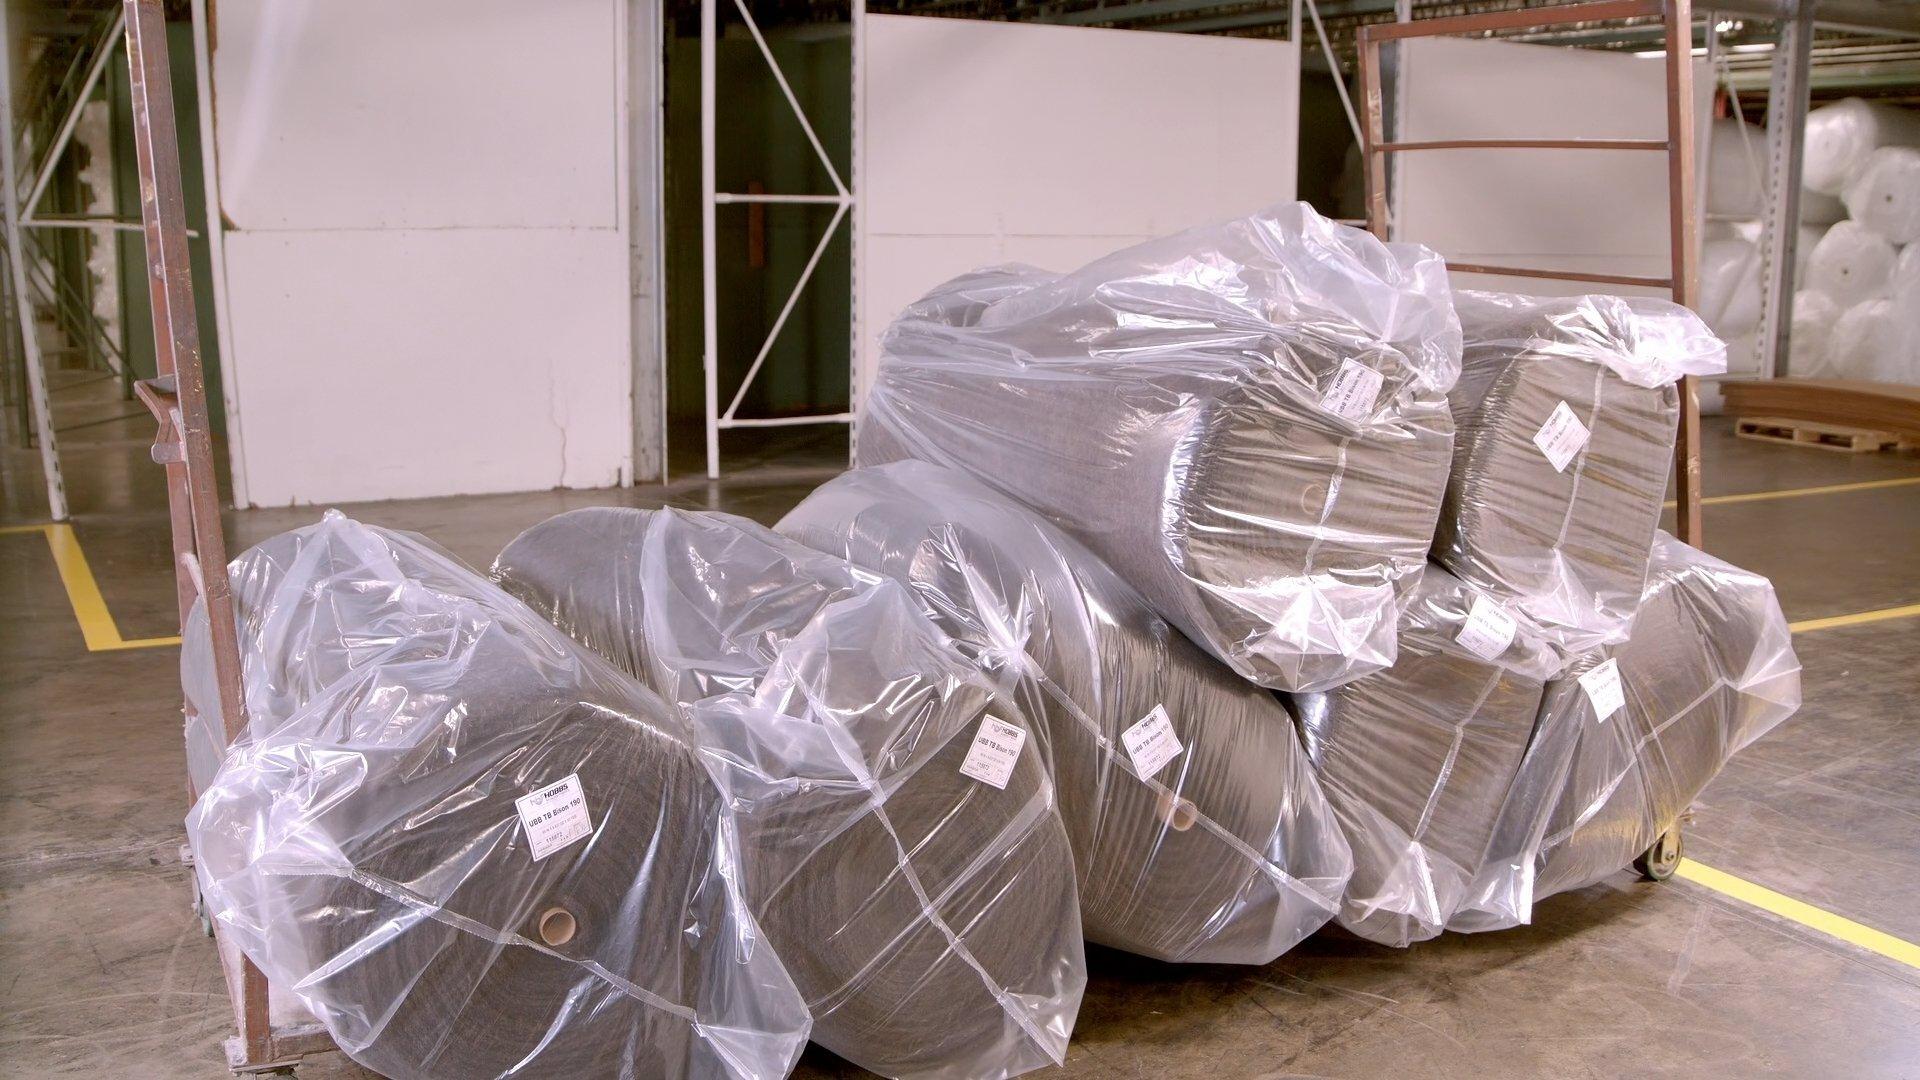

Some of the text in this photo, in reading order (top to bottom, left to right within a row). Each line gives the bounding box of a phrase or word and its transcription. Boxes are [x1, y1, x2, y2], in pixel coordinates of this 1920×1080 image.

[1001, 727, 1019, 739] HOBBS
[977, 736, 989, 746] UBB
[989, 740, 996, 749] TB
[543, 782, 569, 799] HOBBS
[528, 816, 543, 828] UBB
[542, 811, 552, 821] TB
[552, 804, 570, 816] Bison
[569, 797, 581, 808] 190
